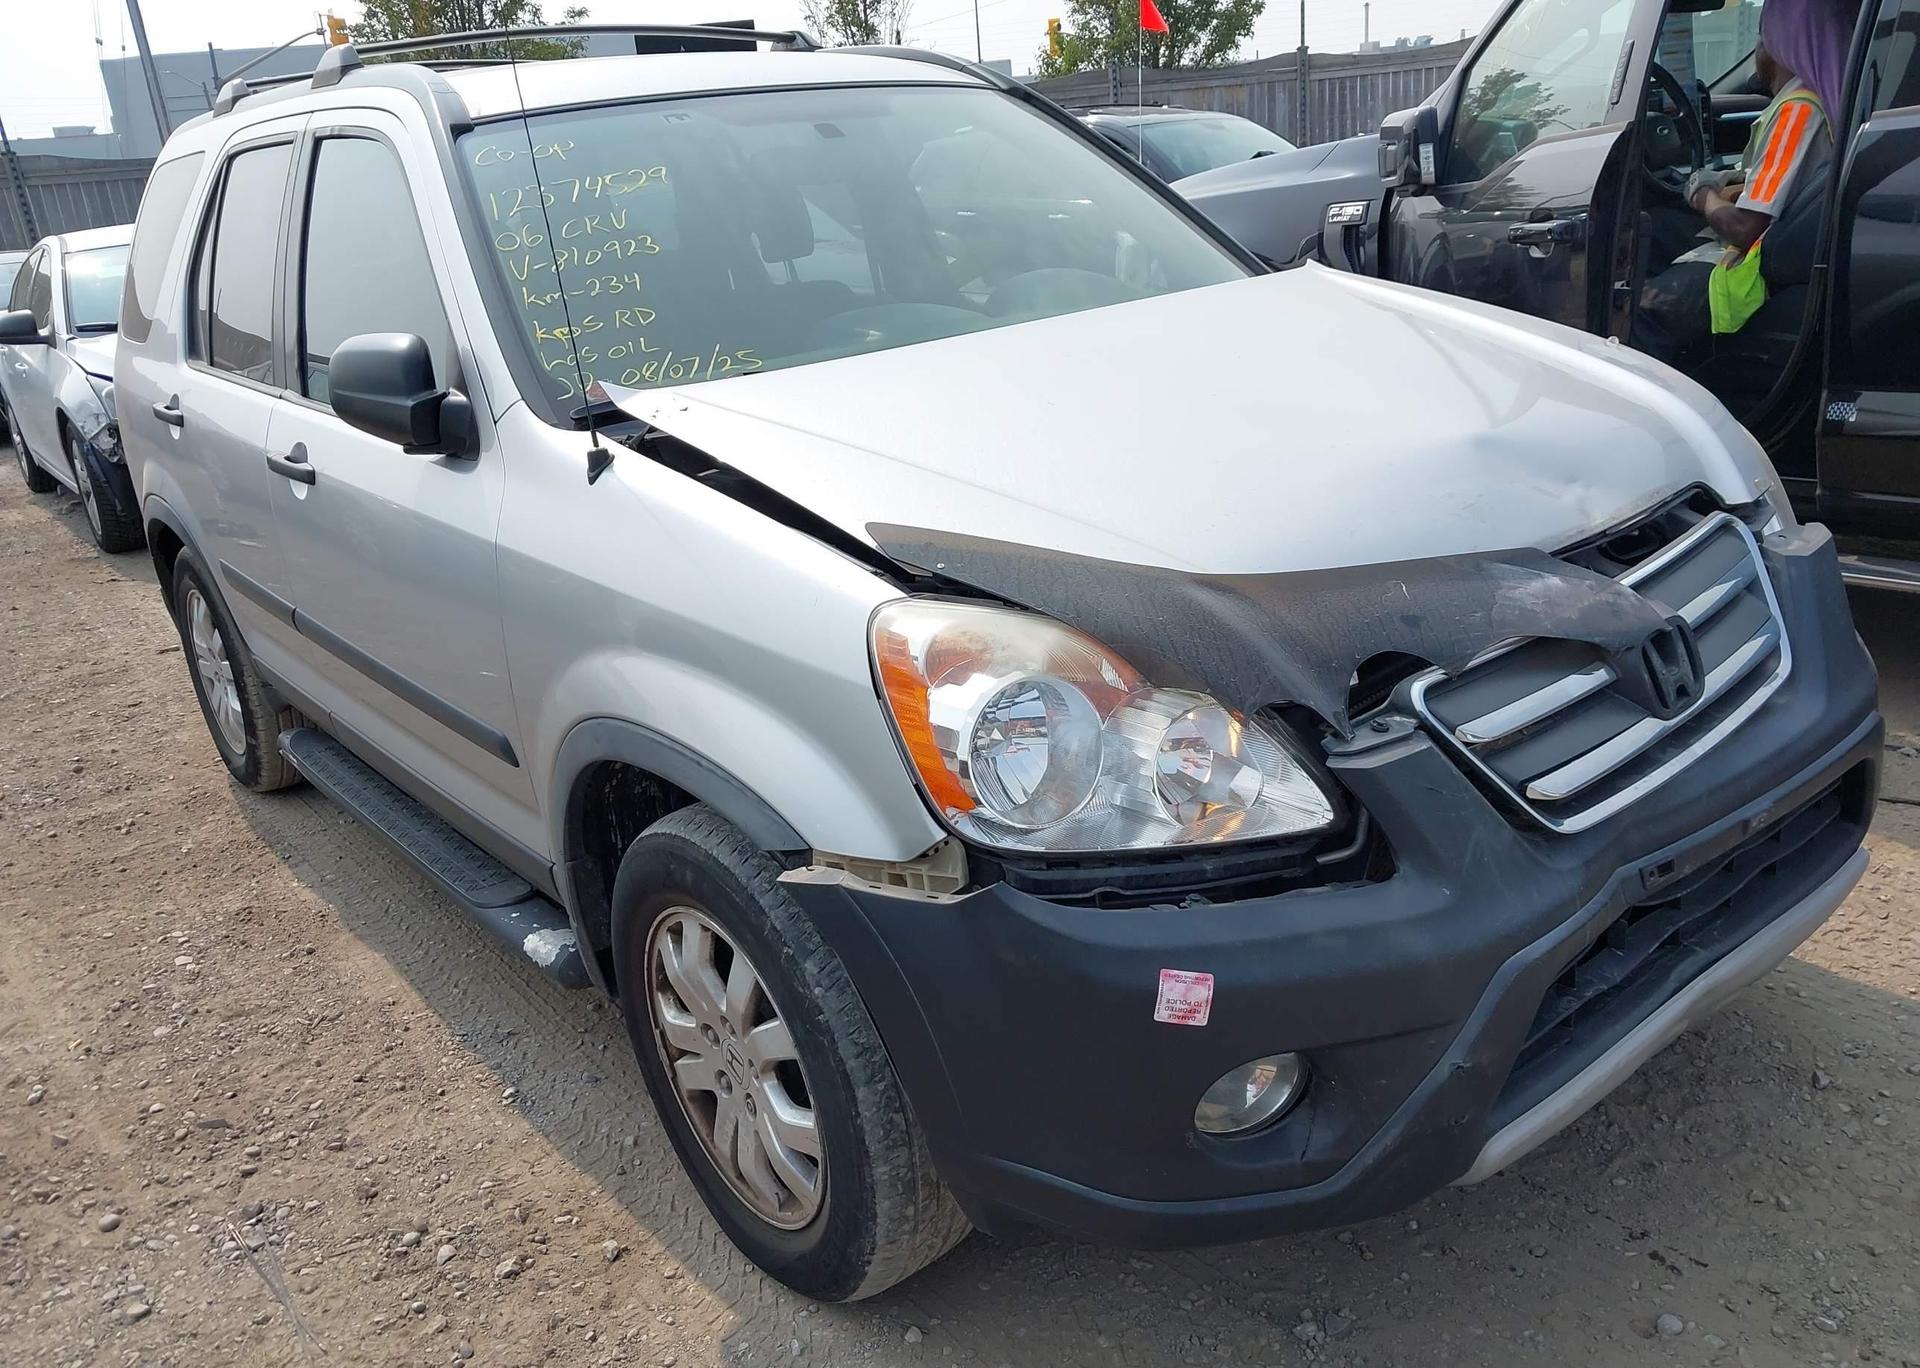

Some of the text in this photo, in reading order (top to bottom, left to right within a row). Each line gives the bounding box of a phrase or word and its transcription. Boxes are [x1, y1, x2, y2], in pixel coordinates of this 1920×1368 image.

[490, 166, 669, 221] 12374529
[495, 223, 544, 251] 06
[615, 307, 657, 328] RD
[620, 343, 763, 386] 08/07/25
[1164, 1005, 1202, 1015] REPORTED
[1165, 998, 1192, 1007] POLICE
[1167, 1013, 1197, 1022] DAMAGE
